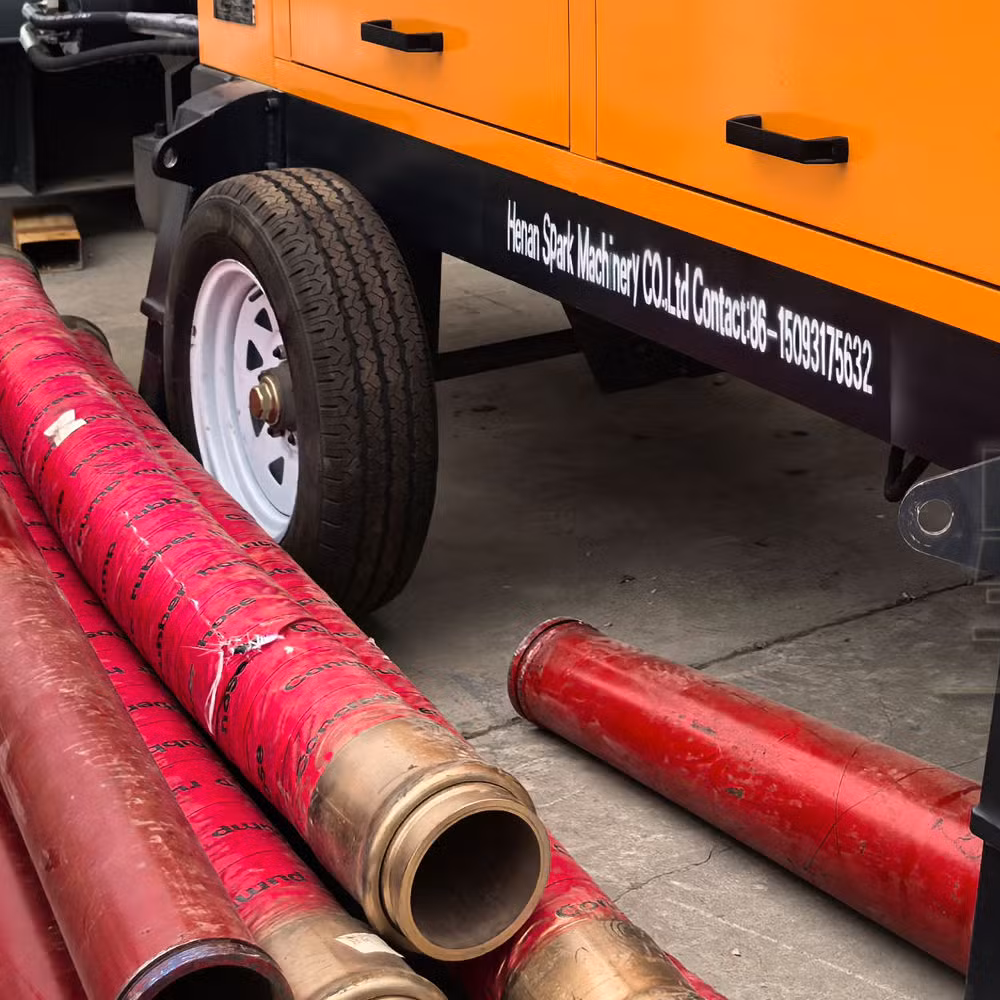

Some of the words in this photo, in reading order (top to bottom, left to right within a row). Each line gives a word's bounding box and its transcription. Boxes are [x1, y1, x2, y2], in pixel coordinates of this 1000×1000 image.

[507, 200, 541, 262] Henan
[542, 212, 575, 274] Spark
[577, 223, 640, 308] Machinery
